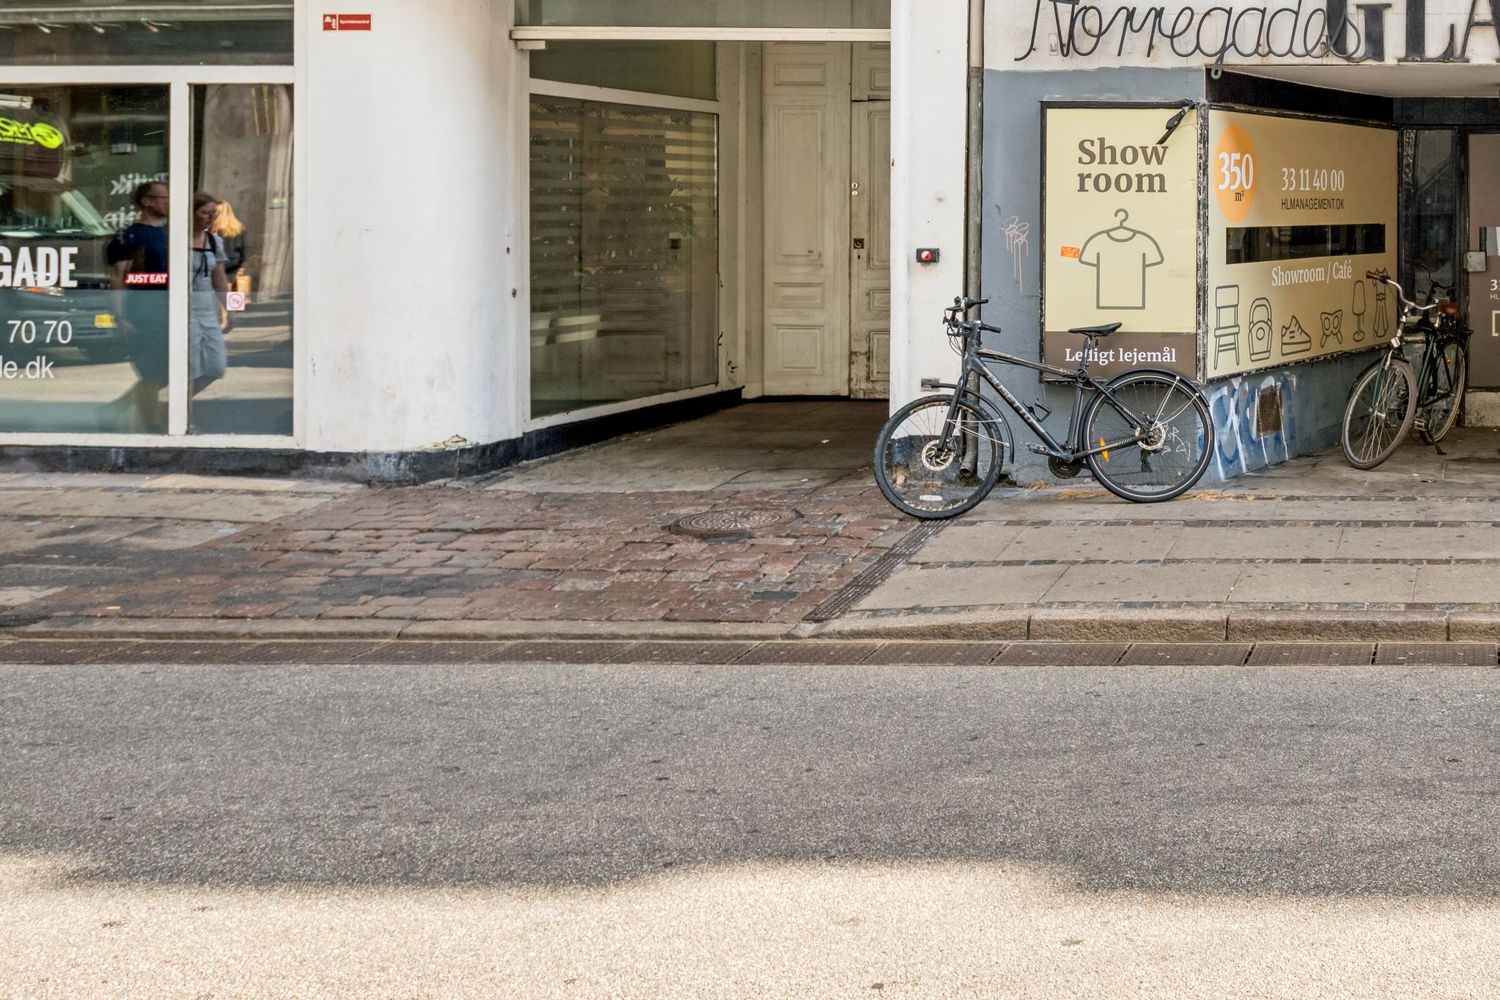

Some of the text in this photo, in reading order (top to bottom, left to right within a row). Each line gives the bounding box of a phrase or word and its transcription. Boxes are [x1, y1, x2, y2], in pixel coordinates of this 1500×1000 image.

[1077, 136, 1169, 166] Show
[1077, 170, 1168, 193] room
[1218, 151, 1254, 190] 350
[1281, 167, 1345, 192] 33 11 40 00
[1281, 198, 1345, 211] HLMANAGEMENT.DK
[125, 273, 168, 284] JUST EAT
[1272, 266, 1325, 286] Showroom
[1333, 259, 1352, 280] Café
[7, 320, 36, 344] 70
[43, 320, 73, 344] 70
[0, 355, 55, 379] e.dk
[1119, 346, 1177, 366] lejemål
